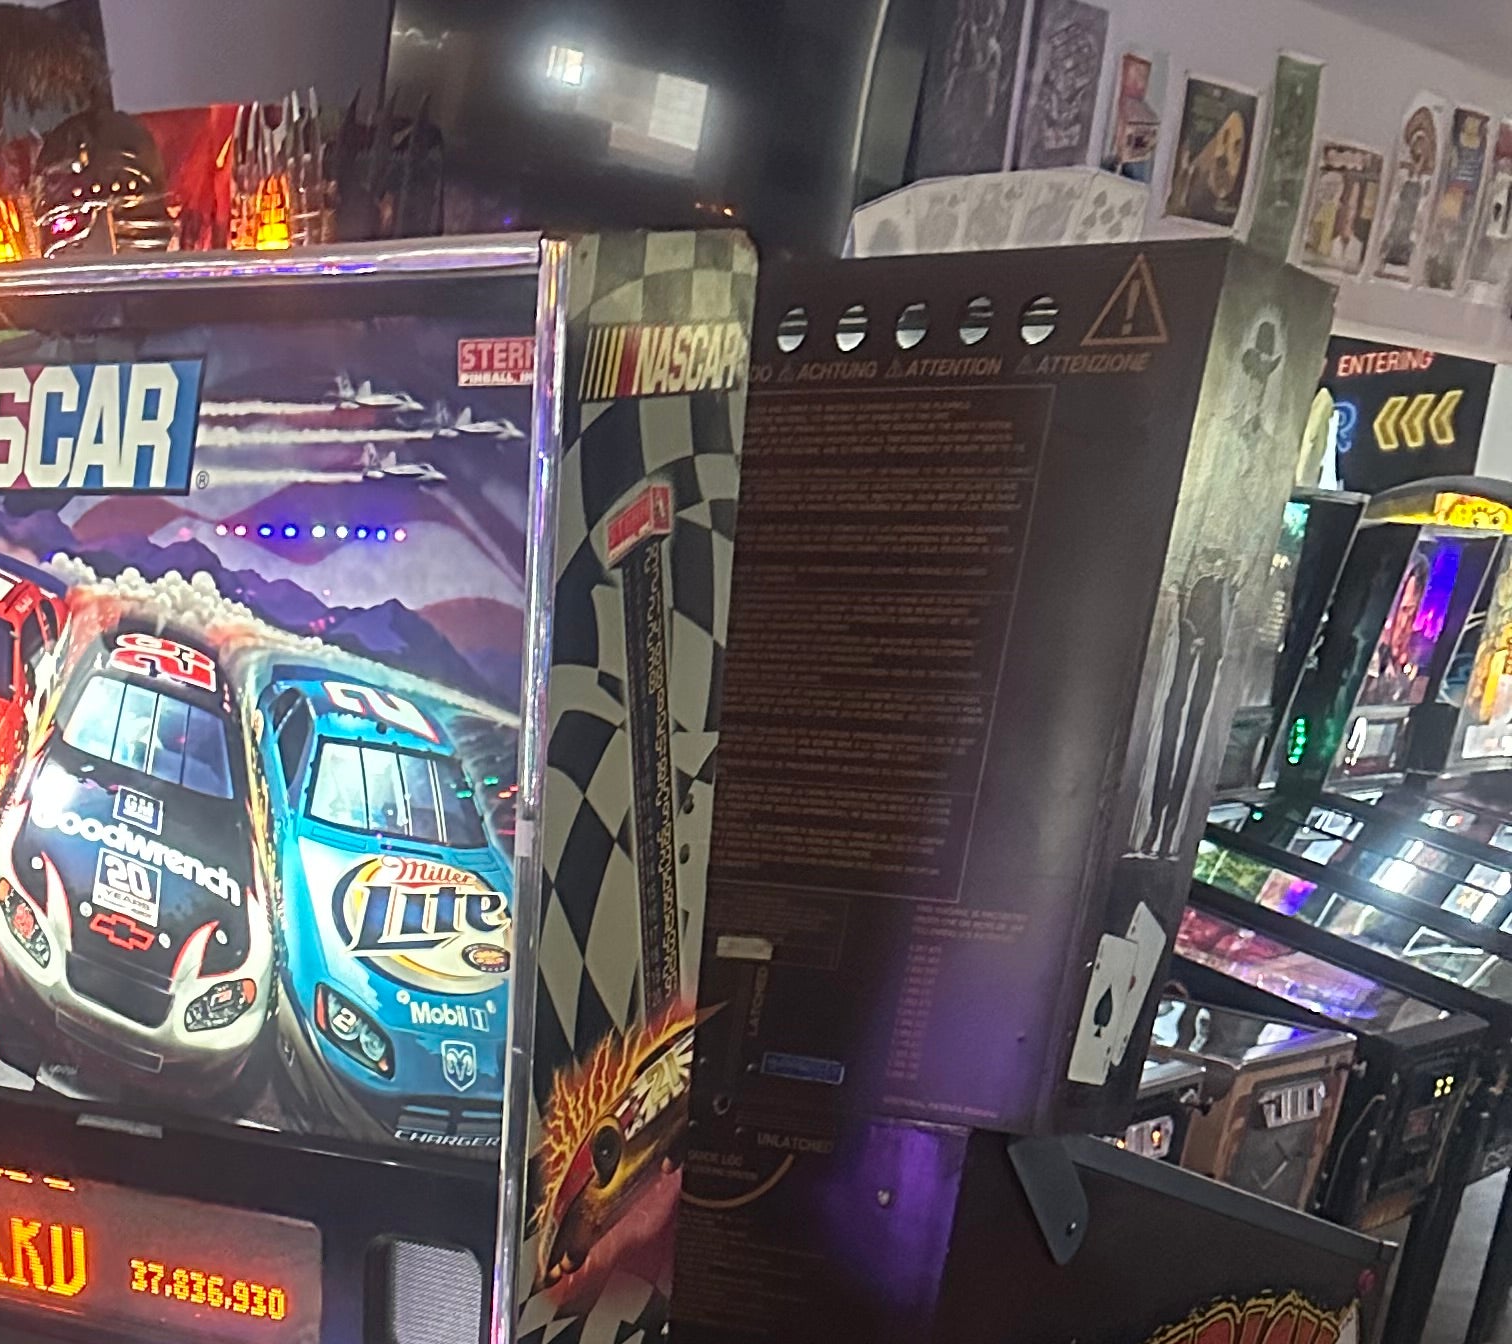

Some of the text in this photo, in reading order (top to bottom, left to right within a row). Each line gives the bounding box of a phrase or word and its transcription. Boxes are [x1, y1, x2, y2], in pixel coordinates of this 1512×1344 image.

[632, 321, 747, 396] NASCAR
[796, 360, 878, 381] ACHTUNG
[906, 357, 1003, 378] ATTENTION
[1038, 351, 1151, 375] ATTENZIONE
[1336, 350, 1437, 378] ENTERING
[31, 803, 241, 908] Goodwrench
[381, 855, 474, 884] Miller
[104, 854, 153, 901] 20
[347, 884, 512, 955] Lite
[409, 1001, 469, 1028] Mobil
[393, 1129, 501, 1147] CHARGER
[756, 1130, 835, 1155] UNLATCHED
[128, 1257, 289, 1322] 37,836,930
